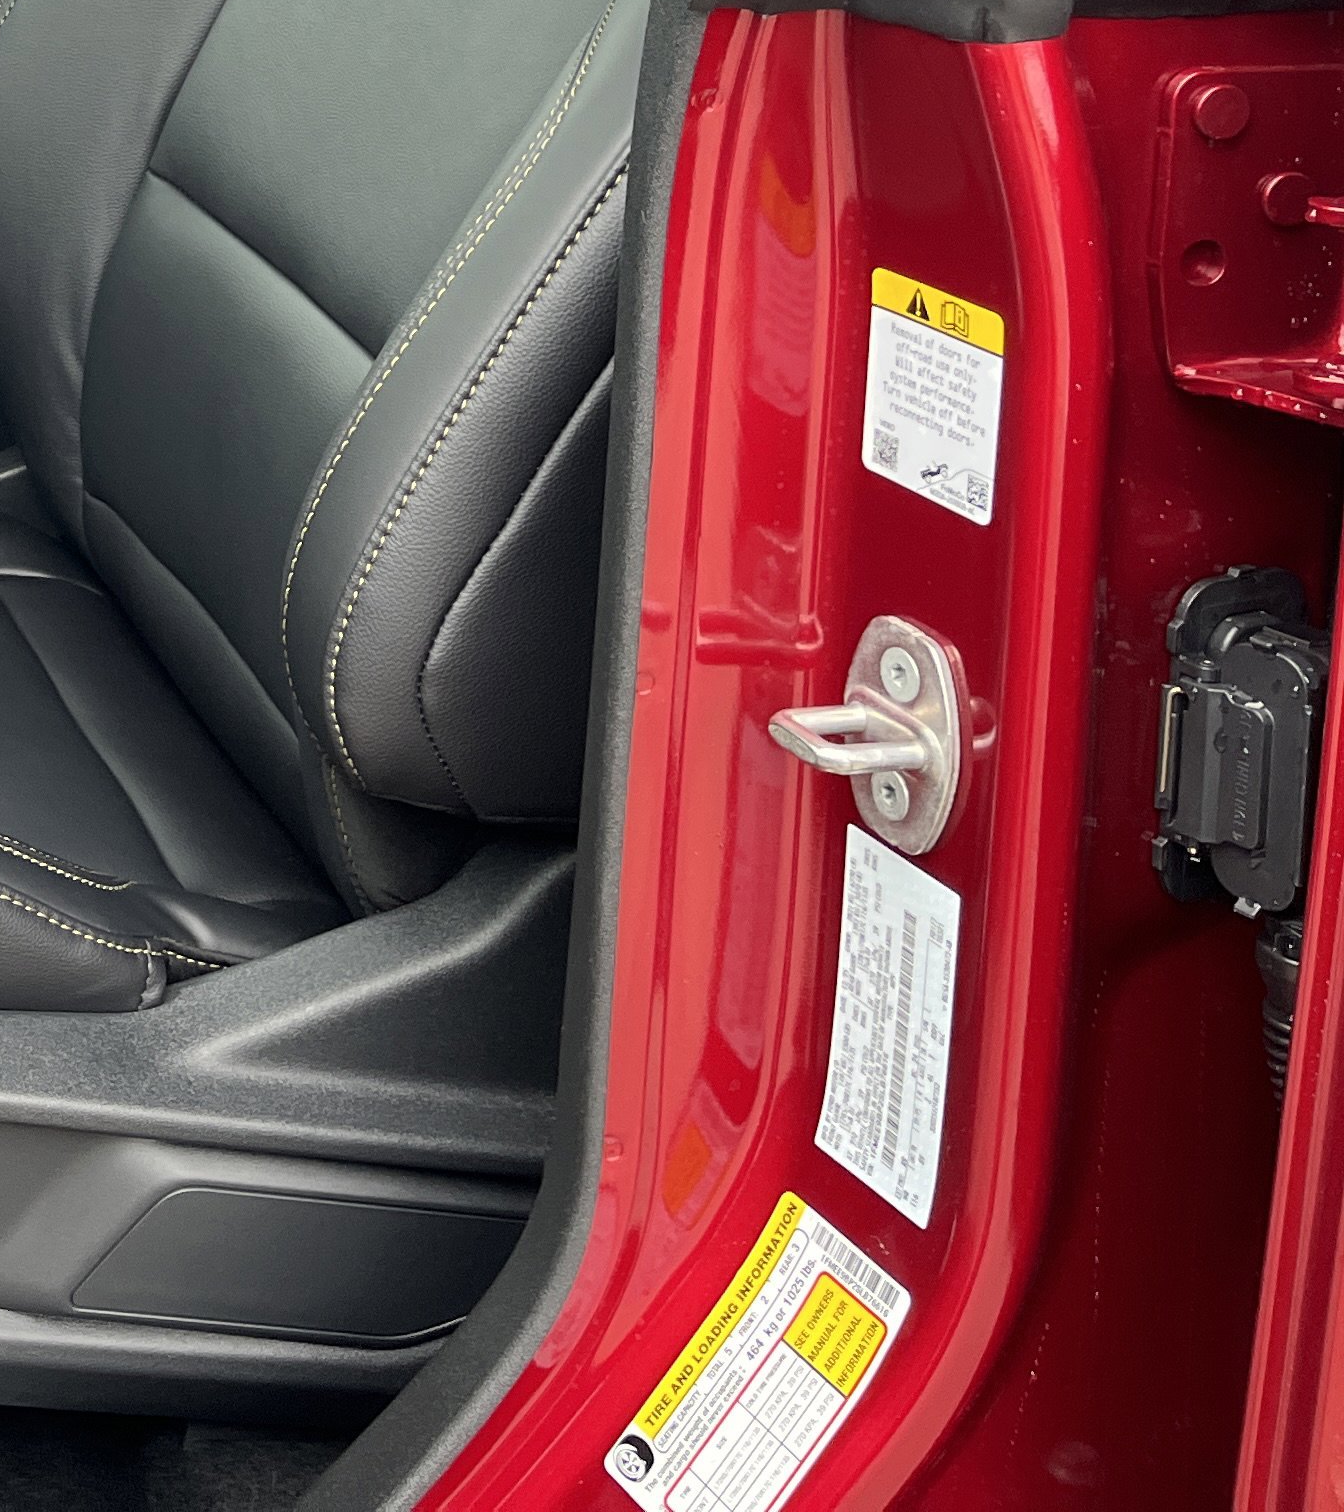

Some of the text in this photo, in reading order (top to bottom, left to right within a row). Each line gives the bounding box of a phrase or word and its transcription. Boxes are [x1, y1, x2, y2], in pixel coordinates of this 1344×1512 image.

[643, 1202, 798, 1428] TIRE AND LOADING INFORMATION
[722, 1346, 733, 1356] 5
[759, 1294, 770, 1305] 2
[789, 1242, 801, 1253] 3
[743, 1255, 819, 1362] 464 kg or 1025 lbs.
[792, 1289, 835, 1350] SEE OWNERS
[806, 1299, 850, 1363] MANUAL FOR
[823, 1315, 862, 1372] ADDITIONAL
[835, 1320, 879, 1388] INFORMATION
